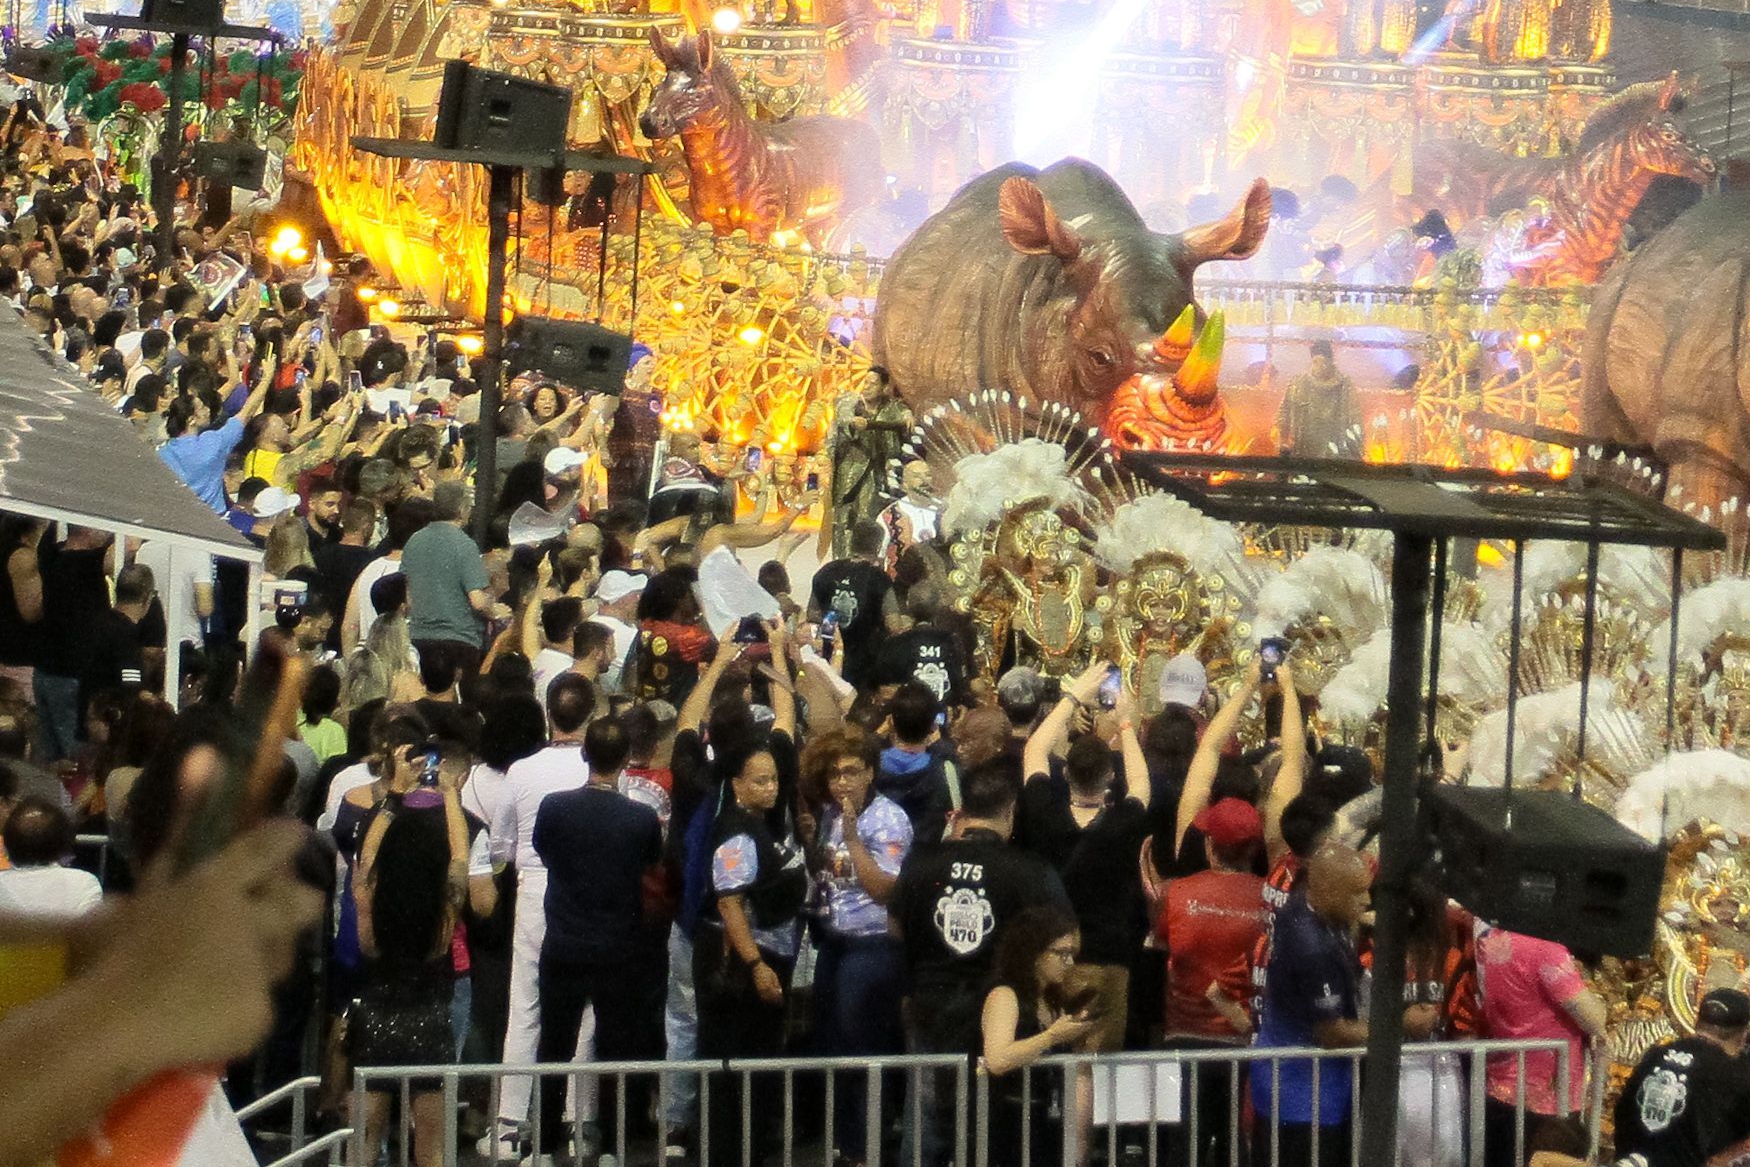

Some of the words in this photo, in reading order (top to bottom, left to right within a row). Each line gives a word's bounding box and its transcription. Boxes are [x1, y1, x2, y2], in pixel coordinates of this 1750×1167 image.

[919, 645, 941, 658] 341
[950, 862, 984, 881] 375
[950, 929, 977, 942] 470
